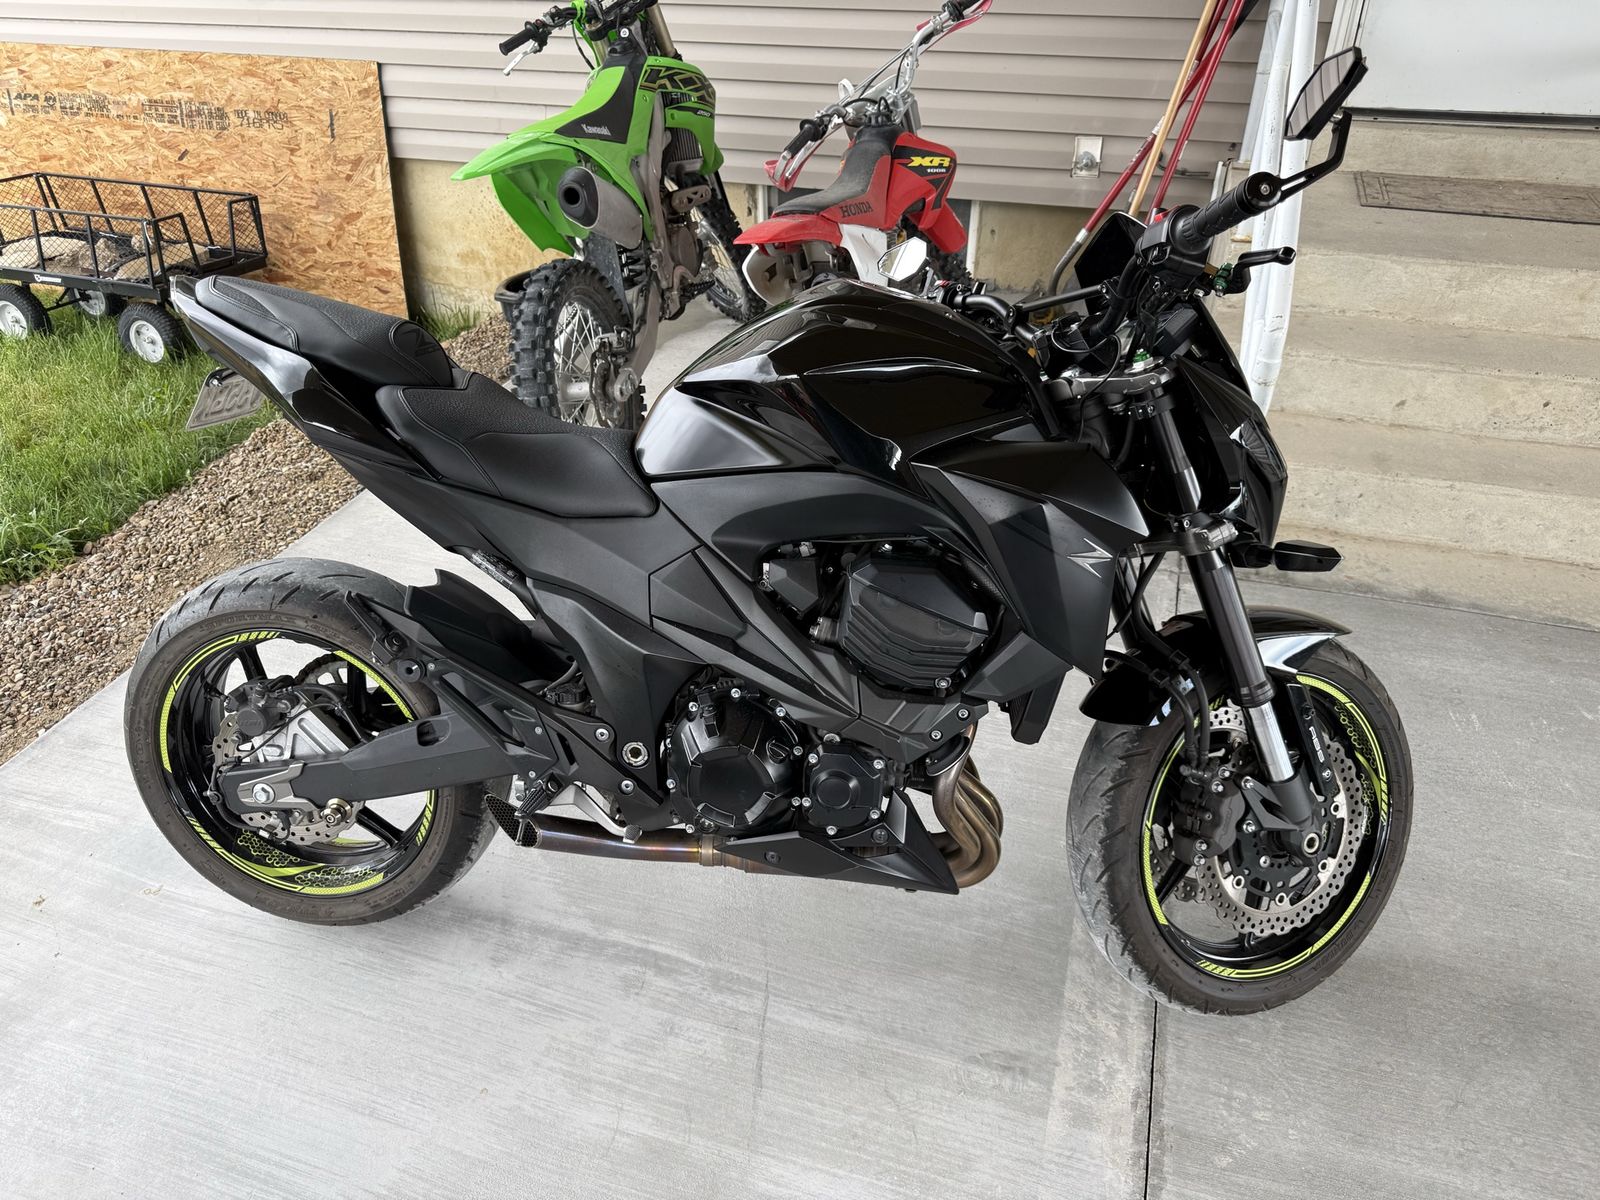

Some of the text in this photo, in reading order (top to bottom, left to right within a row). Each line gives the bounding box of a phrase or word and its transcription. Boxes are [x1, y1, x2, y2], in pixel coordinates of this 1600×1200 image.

[13, 92, 40, 102] APA
[581, 123, 612, 136] Kawasaki
[907, 156, 951, 167] XR
[840, 201, 874, 218] HONDA
[1308, 725, 1325, 763] ABS
